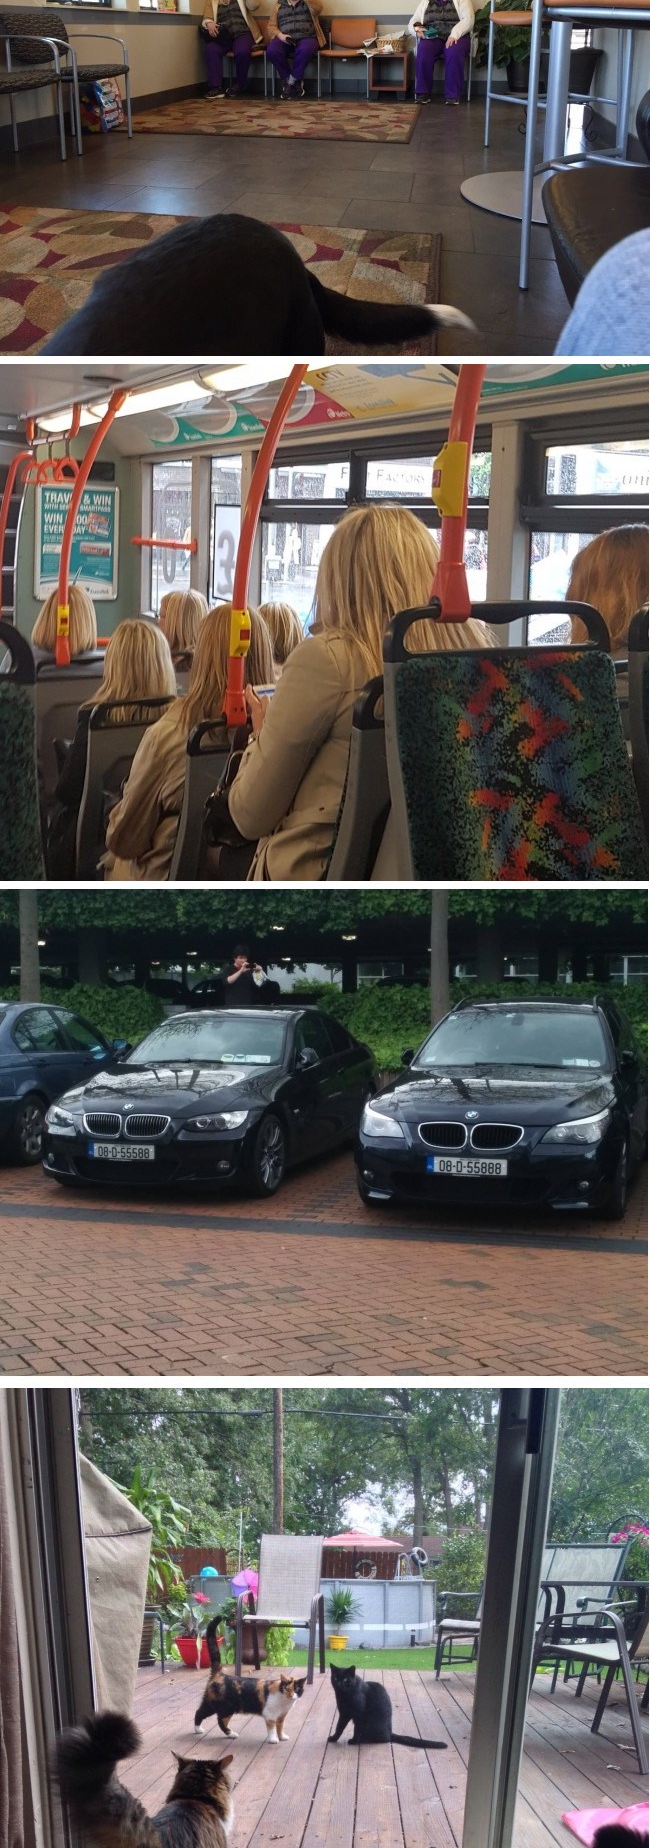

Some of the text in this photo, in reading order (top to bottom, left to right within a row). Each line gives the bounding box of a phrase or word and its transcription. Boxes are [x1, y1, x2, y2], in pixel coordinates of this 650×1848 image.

[44, 492, 76, 504] TRAV
[93, 495, 112, 506] WIN
[44, 513, 63, 523] WIN
[44, 524, 65, 534] EVER
[97, 1146, 150, 1159] 08-D-55588
[439, 1159, 502, 1175] 08-D-55888
